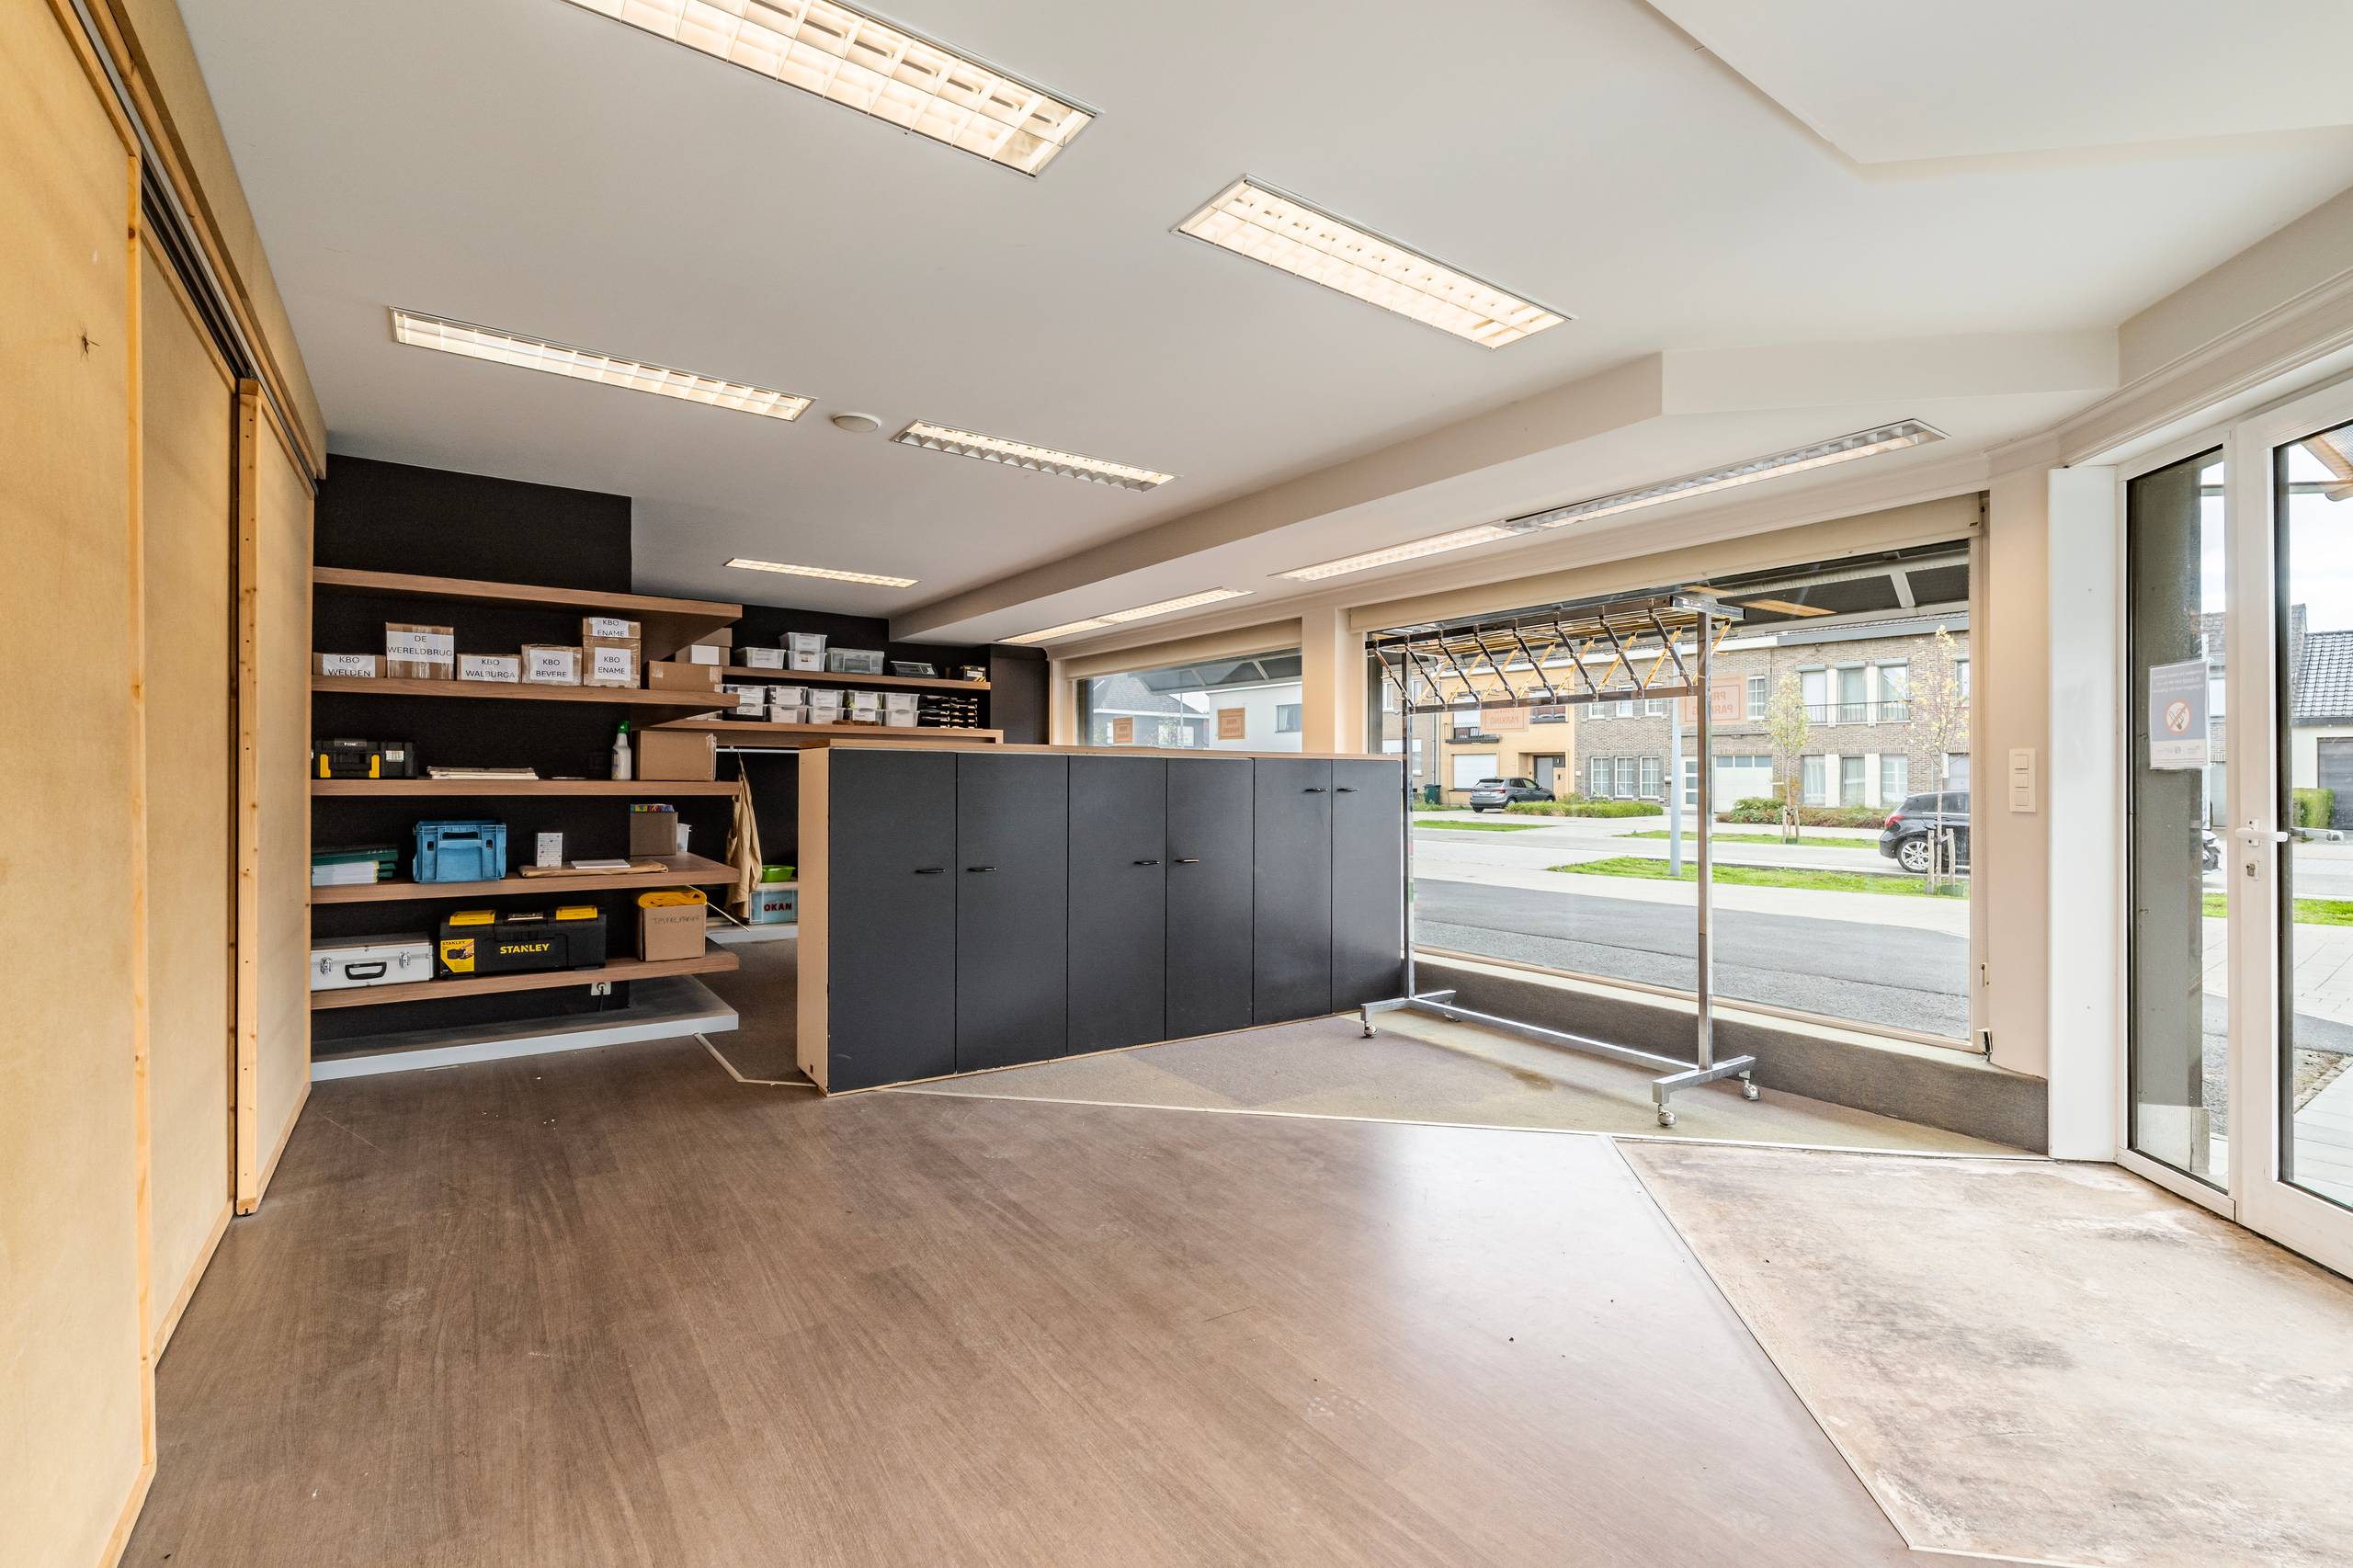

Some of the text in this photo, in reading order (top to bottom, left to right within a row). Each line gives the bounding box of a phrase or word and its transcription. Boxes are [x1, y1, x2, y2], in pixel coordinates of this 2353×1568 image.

[387, 646, 453, 656] WERELDBRUG
[338, 655, 360, 664] KBO
[327, 668, 371, 677] WELDEN
[465, 670, 516, 678] WALBURGA
[535, 670, 567, 678] BEVERE
[597, 666, 625, 675] ENAME
[764, 903, 792, 912] OKAN
[499, 943, 550, 954] STANLEY
